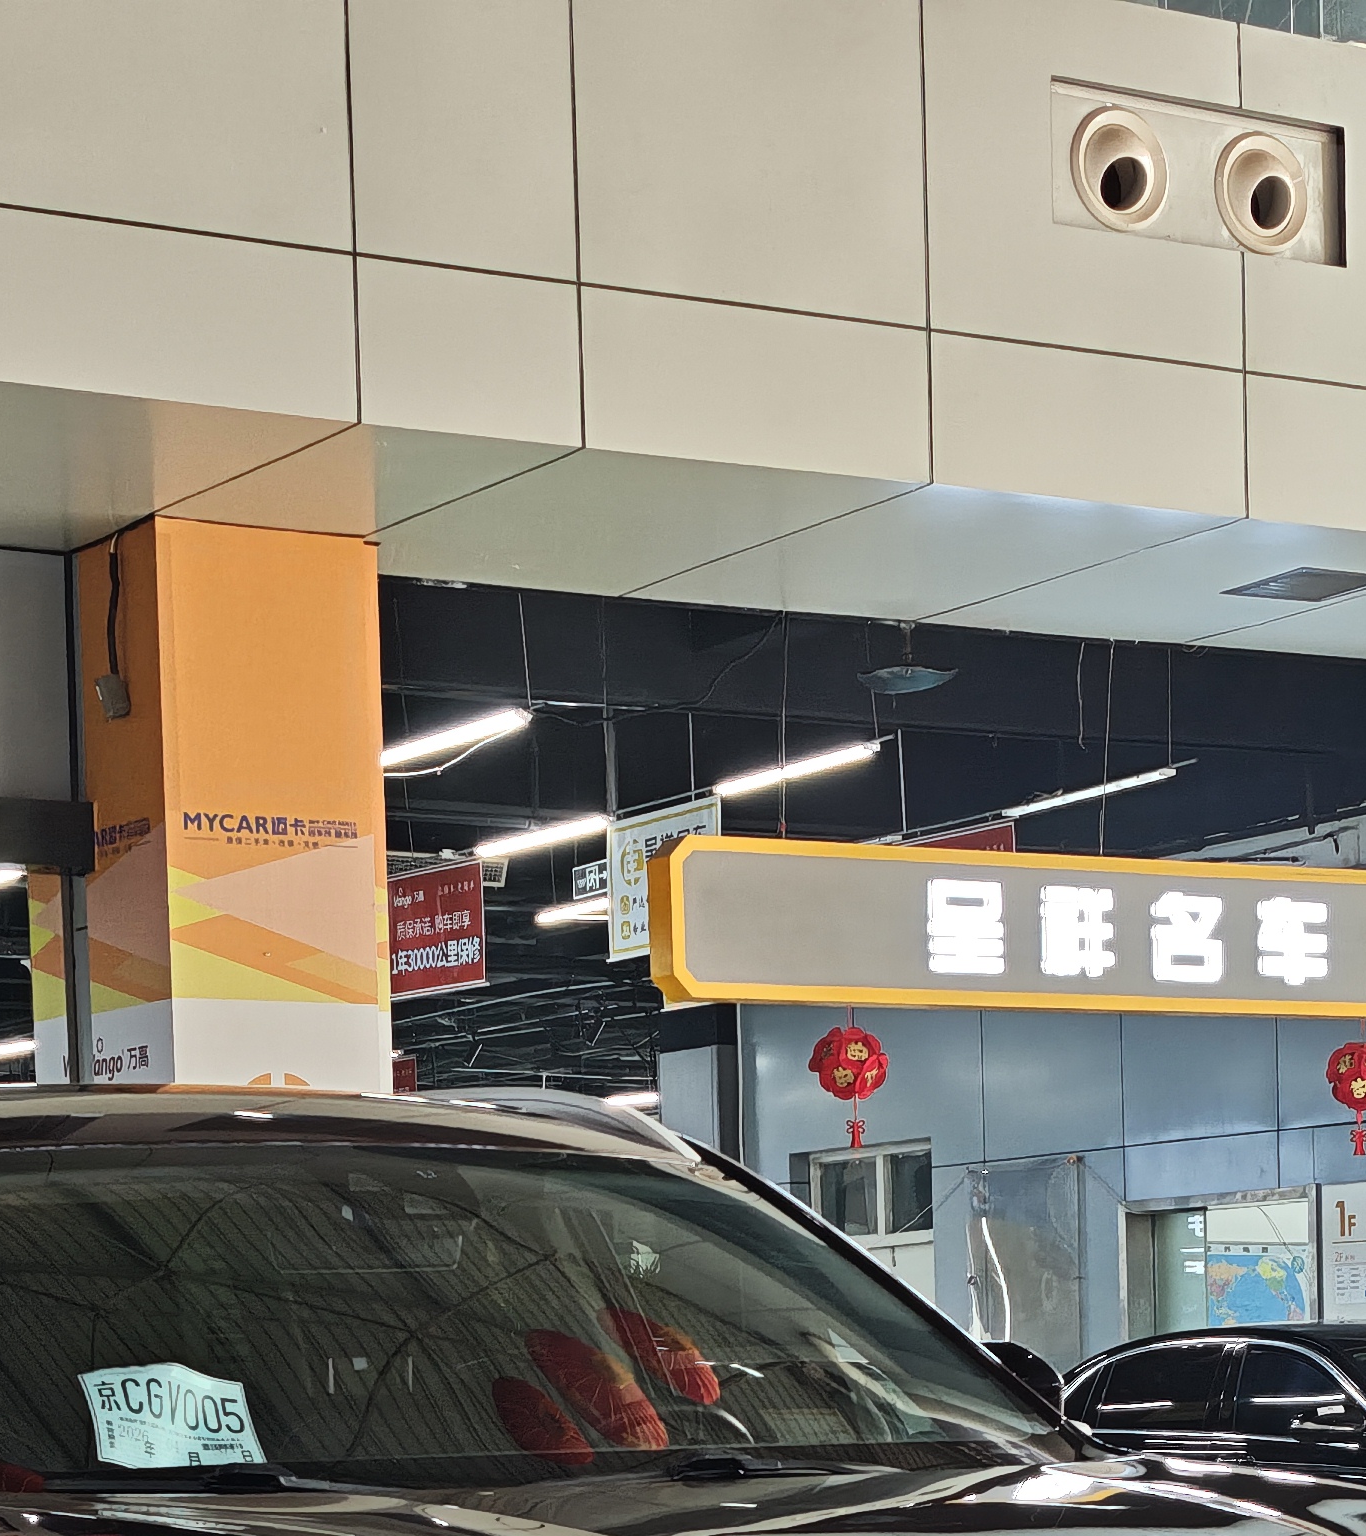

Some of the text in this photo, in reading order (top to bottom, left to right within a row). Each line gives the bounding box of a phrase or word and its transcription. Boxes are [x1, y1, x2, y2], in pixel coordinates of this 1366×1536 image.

[391, 936, 481, 976] 1年30000公里保修
[127, 1045, 149, 1070] 万高
[1335, 1200, 1357, 1237] 1F
